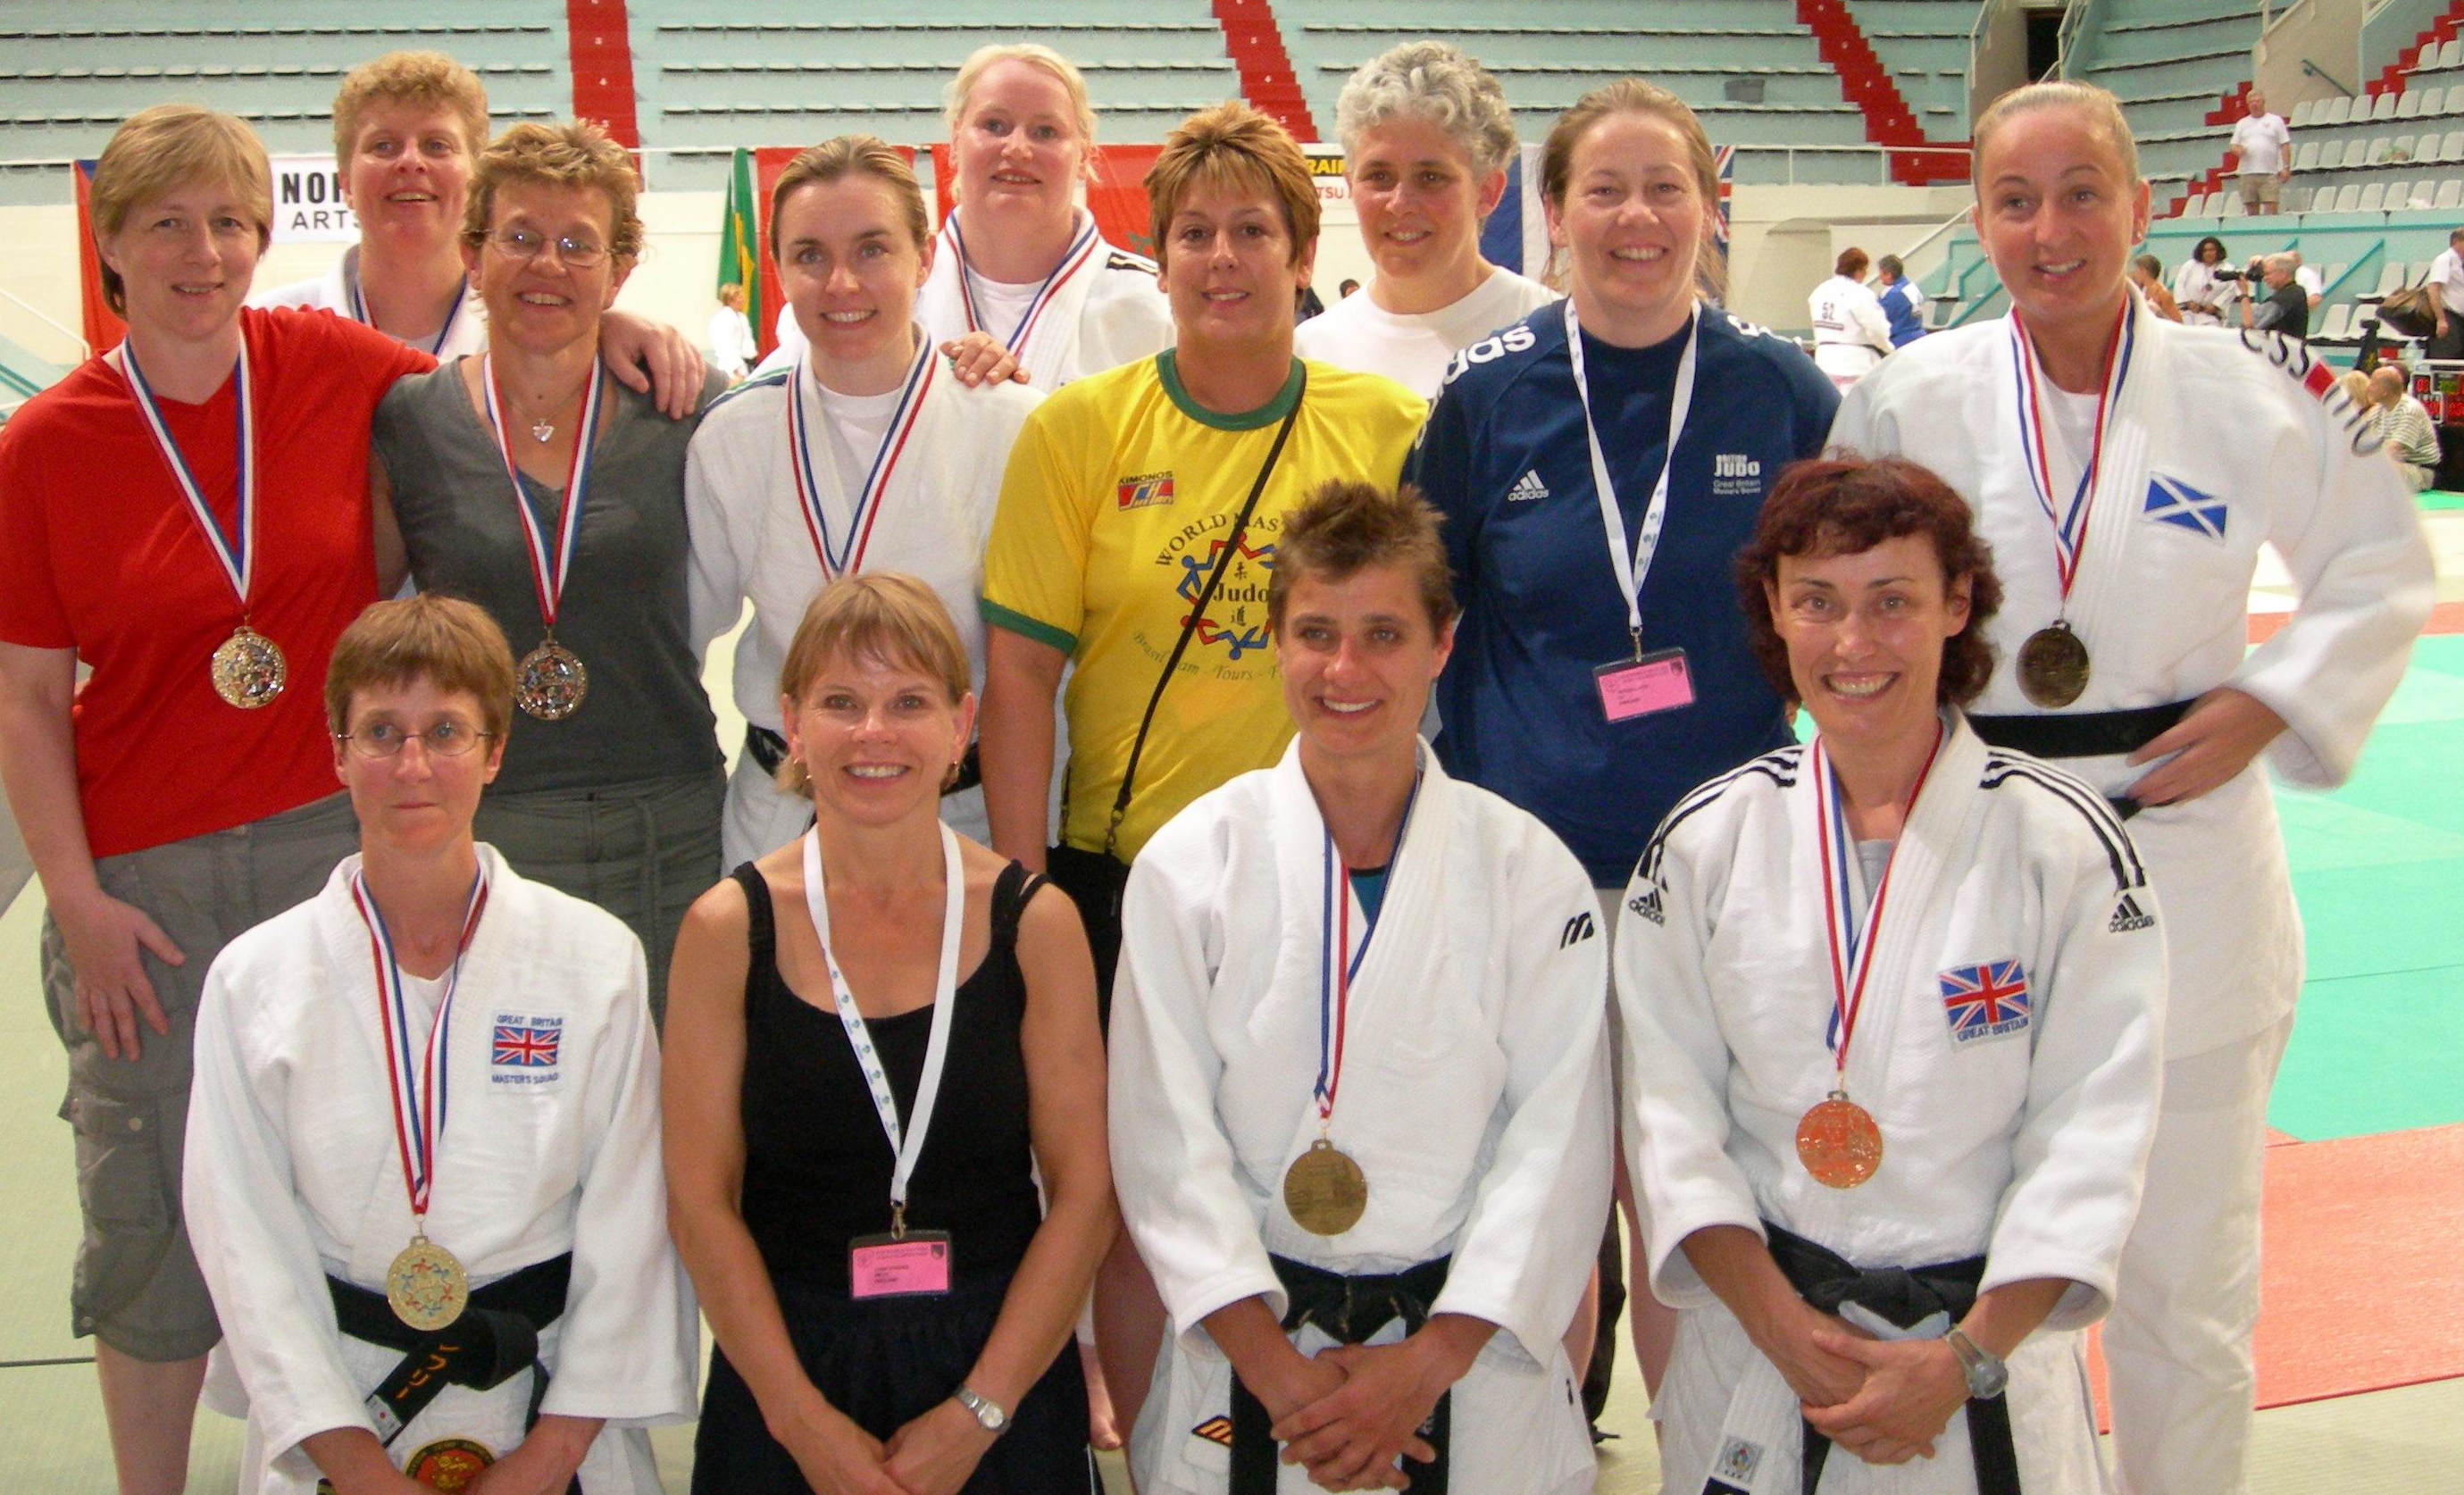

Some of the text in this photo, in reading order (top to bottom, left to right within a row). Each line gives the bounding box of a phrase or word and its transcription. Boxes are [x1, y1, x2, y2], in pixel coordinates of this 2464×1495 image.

[1822, 302, 1834, 320] 52
[1119, 470, 1174, 484] KIMONOS
[1714, 461, 1760, 477] JUDO
[1508, 489, 1549, 502] adidas
[1155, 513, 1227, 566] WORLD
[1213, 582, 1269, 603] Judo
[1213, 665, 1253, 681] Tours
[2109, 915, 2155, 933] adidas
[497, 1015, 563, 1027] GREAT BRITAIN
[1957, 1016, 2029, 1042] GREAT BRITAIN
